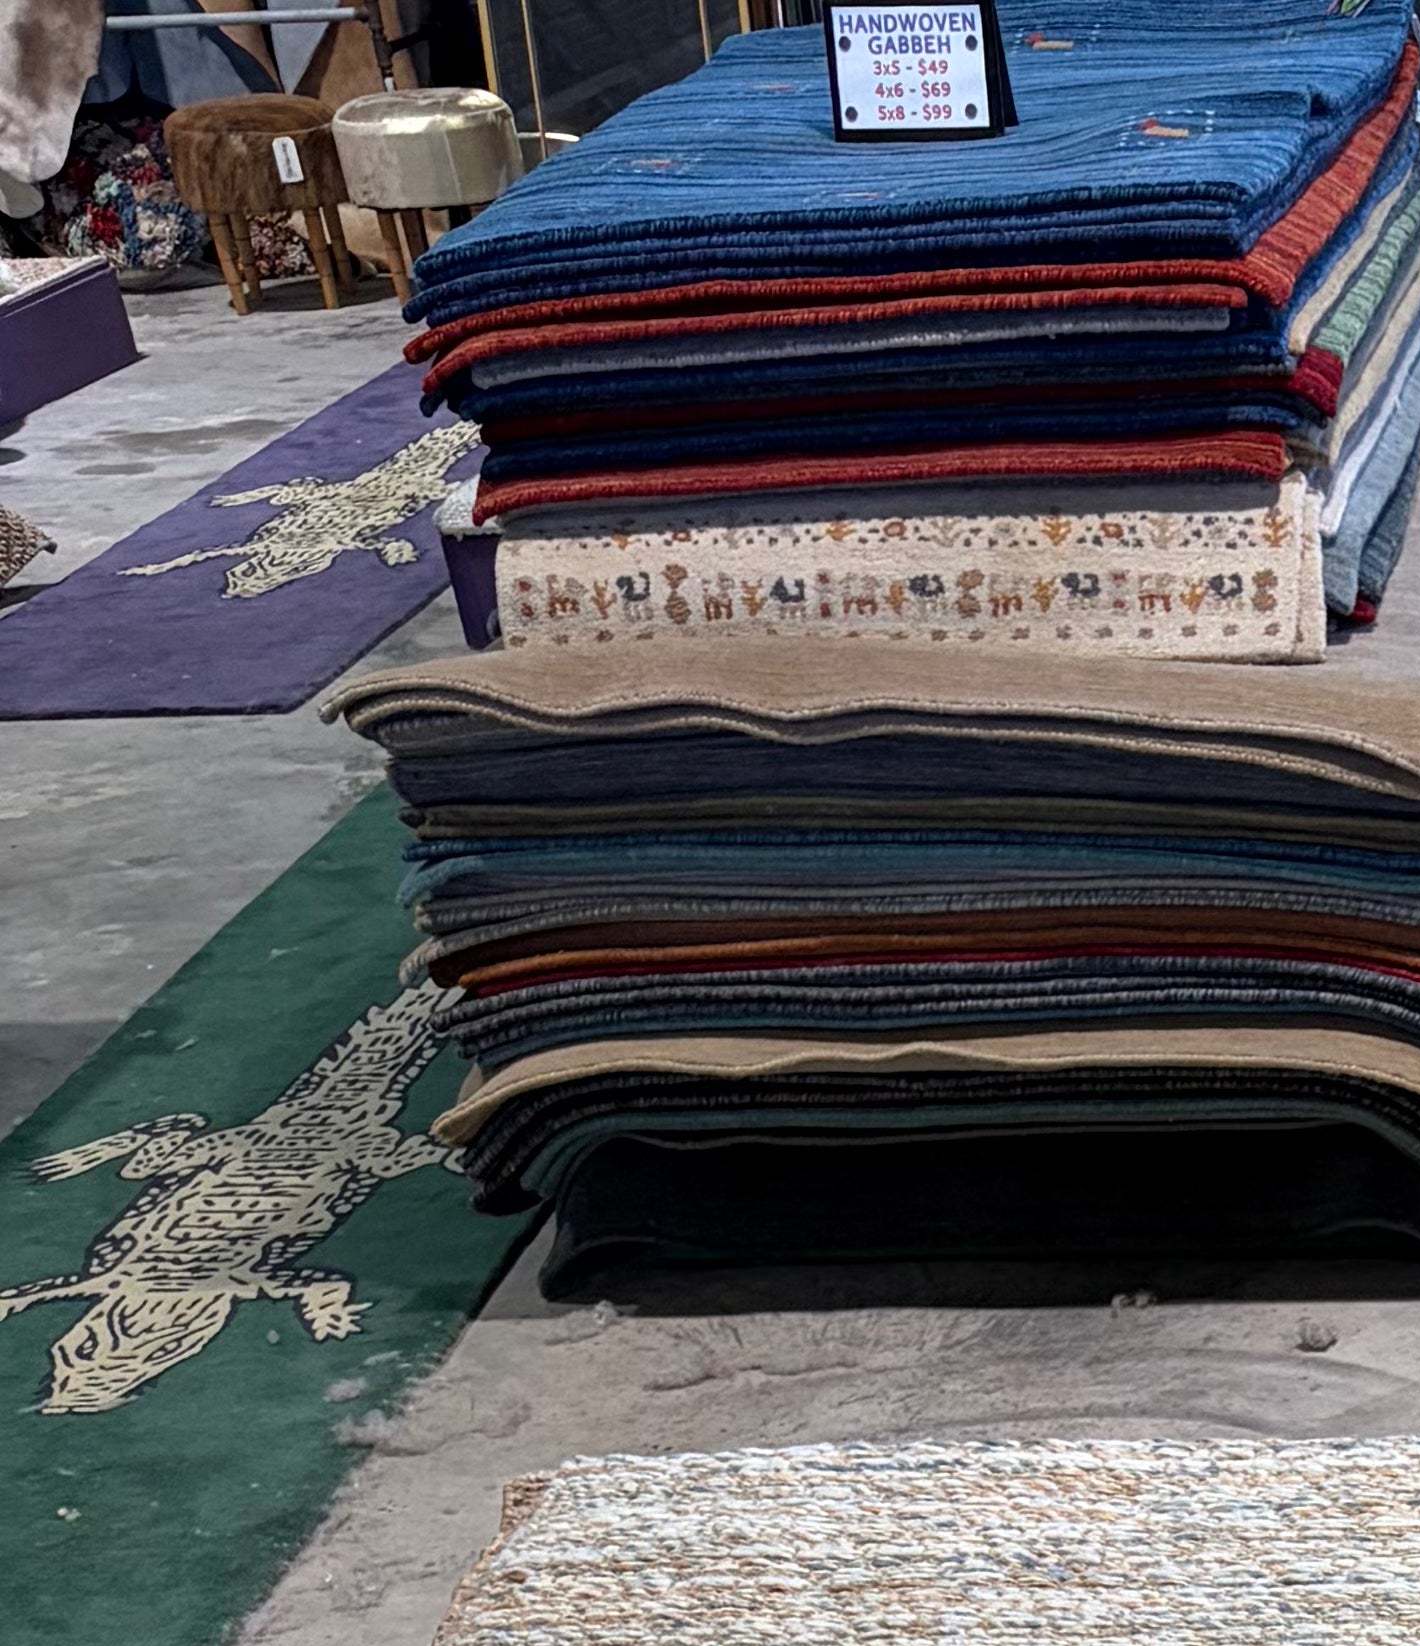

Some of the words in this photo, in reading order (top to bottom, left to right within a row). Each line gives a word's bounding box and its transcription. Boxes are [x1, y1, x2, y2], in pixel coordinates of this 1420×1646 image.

[838, 12, 977, 34] HANDWOVEN
[867, 34, 951, 55] GABBEH
[872, 60, 901, 76] 3x5
[917, 57, 949, 76] $49
[874, 82, 904, 99] 4x6
[920, 80, 951, 99] $69
[877, 105, 906, 121] 5x8
[922, 103, 953, 121] $99
